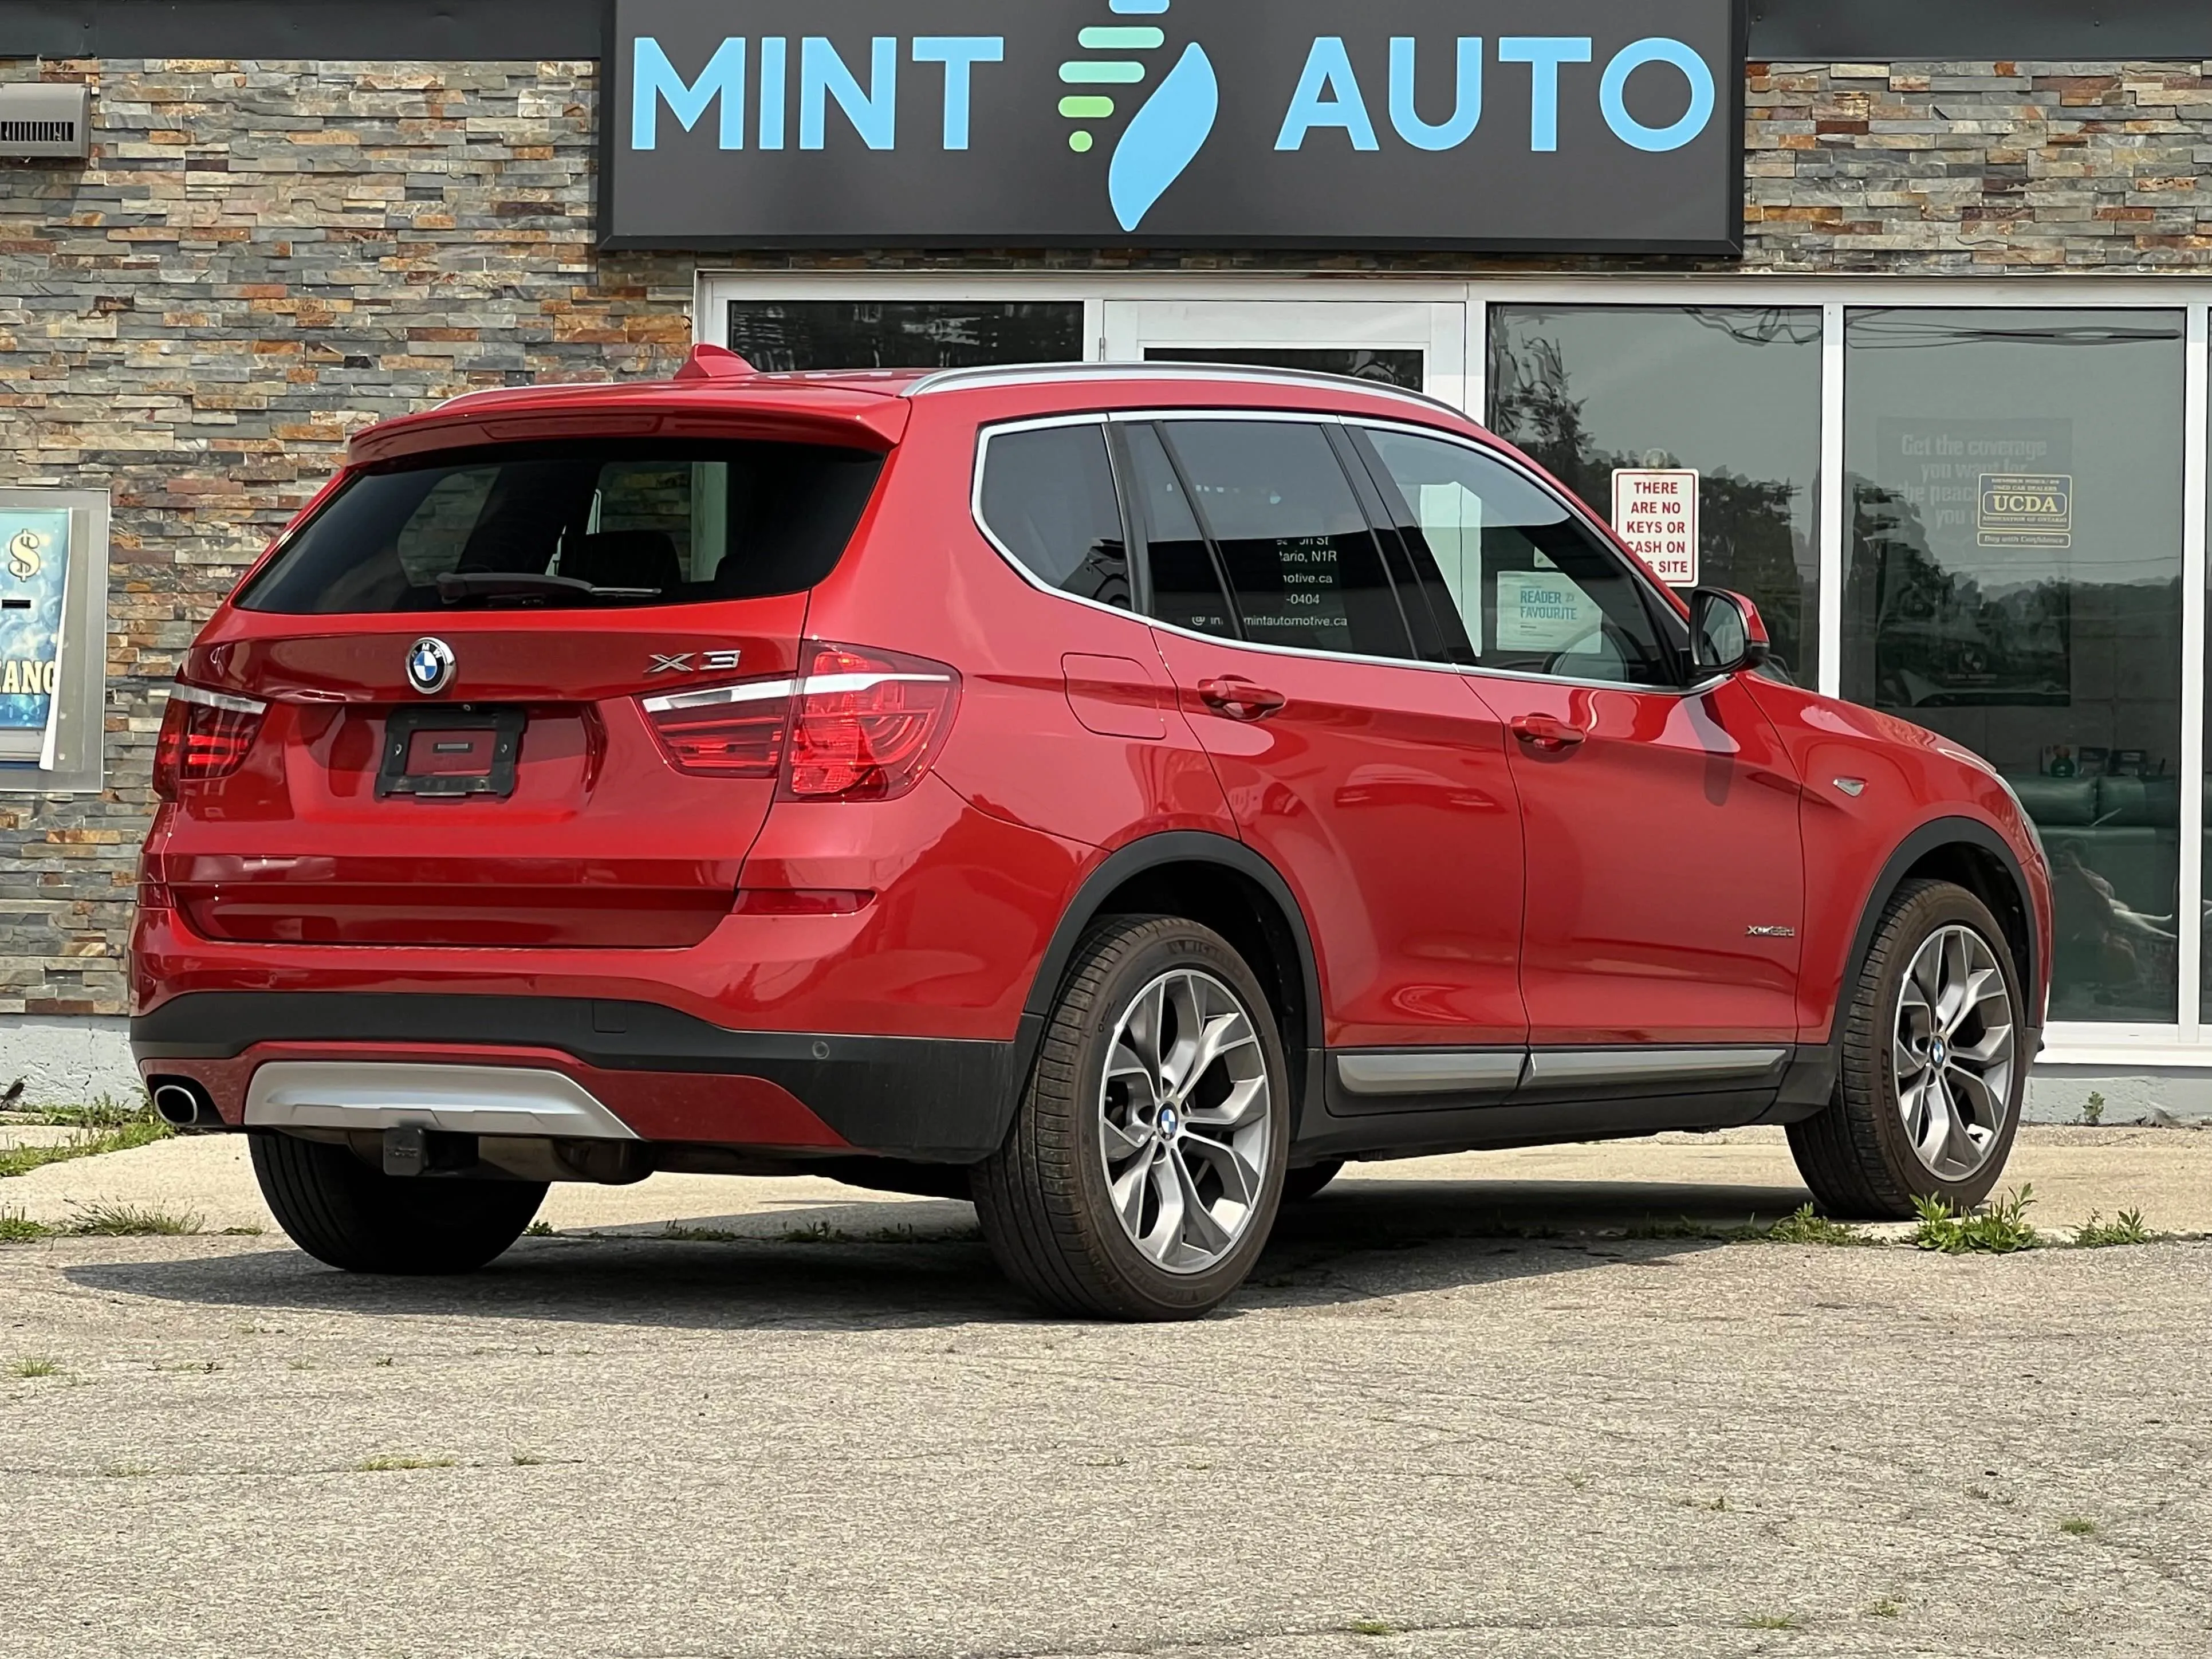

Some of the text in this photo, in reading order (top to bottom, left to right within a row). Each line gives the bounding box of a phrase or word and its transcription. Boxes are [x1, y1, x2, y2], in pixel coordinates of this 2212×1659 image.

[632, 37, 1715, 151] MINT AUTO
[1902, 433, 2047, 460] Get the coverage
[1920, 460, 1951, 483] you
[1634, 482, 1678, 494] THERE
[1631, 502, 1681, 514] ARE NO
[1993, 495, 2058, 513] UCDA
[1935, 509, 1966, 530] you
[1627, 521, 1685, 533] KEYS OR
[1667, 541, 1685, 553] ON
[1280, 549, 1337, 563] tario, N1R
[1658, 561, 1688, 573] SITE
[1285, 593, 1320, 605] -0404
[1520, 590, 1561, 604] READER
[1520, 606, 1577, 620] FAVOURITE
[643, 650, 741, 673] X3
[0, 660, 56, 694] ANG
